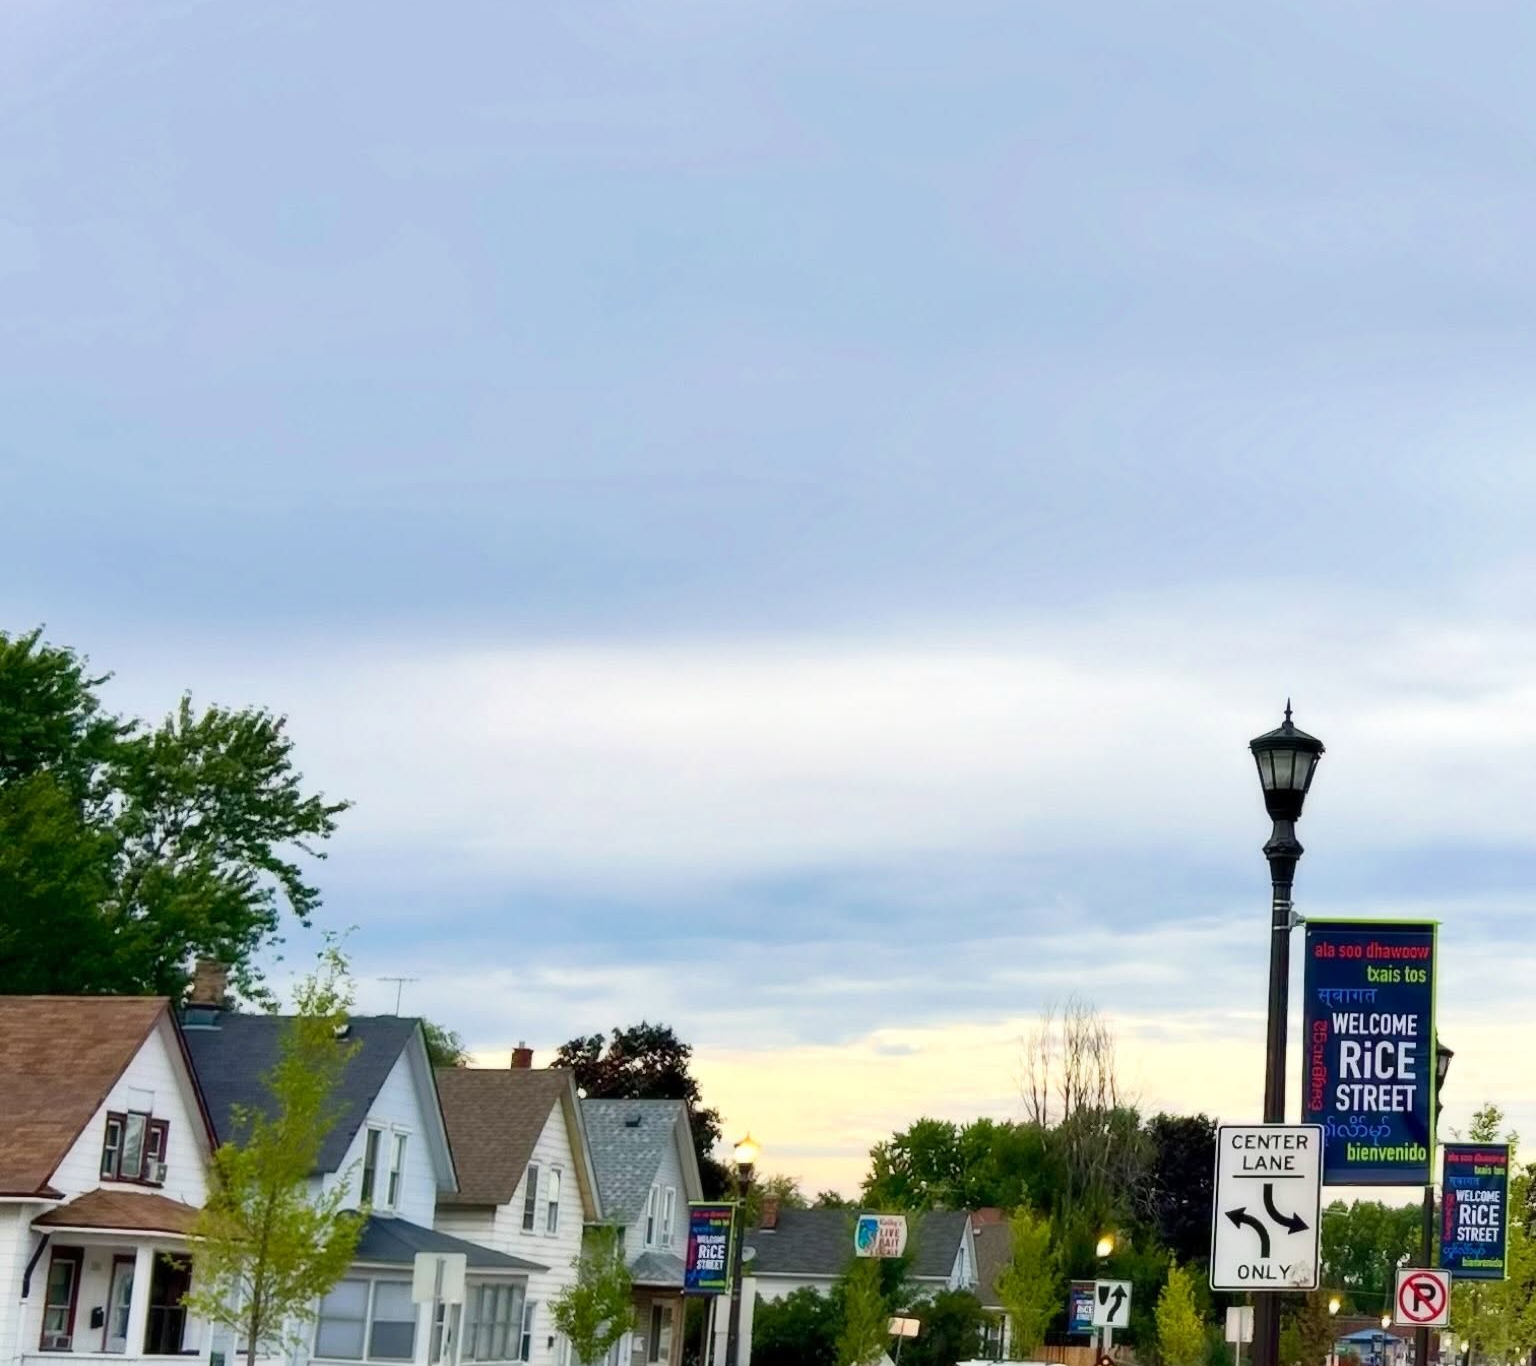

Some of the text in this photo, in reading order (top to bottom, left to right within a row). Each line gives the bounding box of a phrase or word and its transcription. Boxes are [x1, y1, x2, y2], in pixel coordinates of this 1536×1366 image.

[1315, 942, 1430, 960] ala soo dhawoow
[1367, 964, 1427, 983] txais tos
[1332, 1012, 1418, 1036] WELCOME
[1339, 1039, 1417, 1081] RiCE
[1335, 1083, 1417, 1113] STREET
[1231, 1134, 1309, 1150] CENTER
[1346, 1141, 1427, 1162] bienvenido
[1242, 1155, 1295, 1171] LANE
[1456, 1189, 1500, 1203] WELCOME
[1459, 1204, 1500, 1226] RiCE
[1456, 1227, 1500, 1243] STREET
[1237, 1264, 1291, 1280] ONLY
